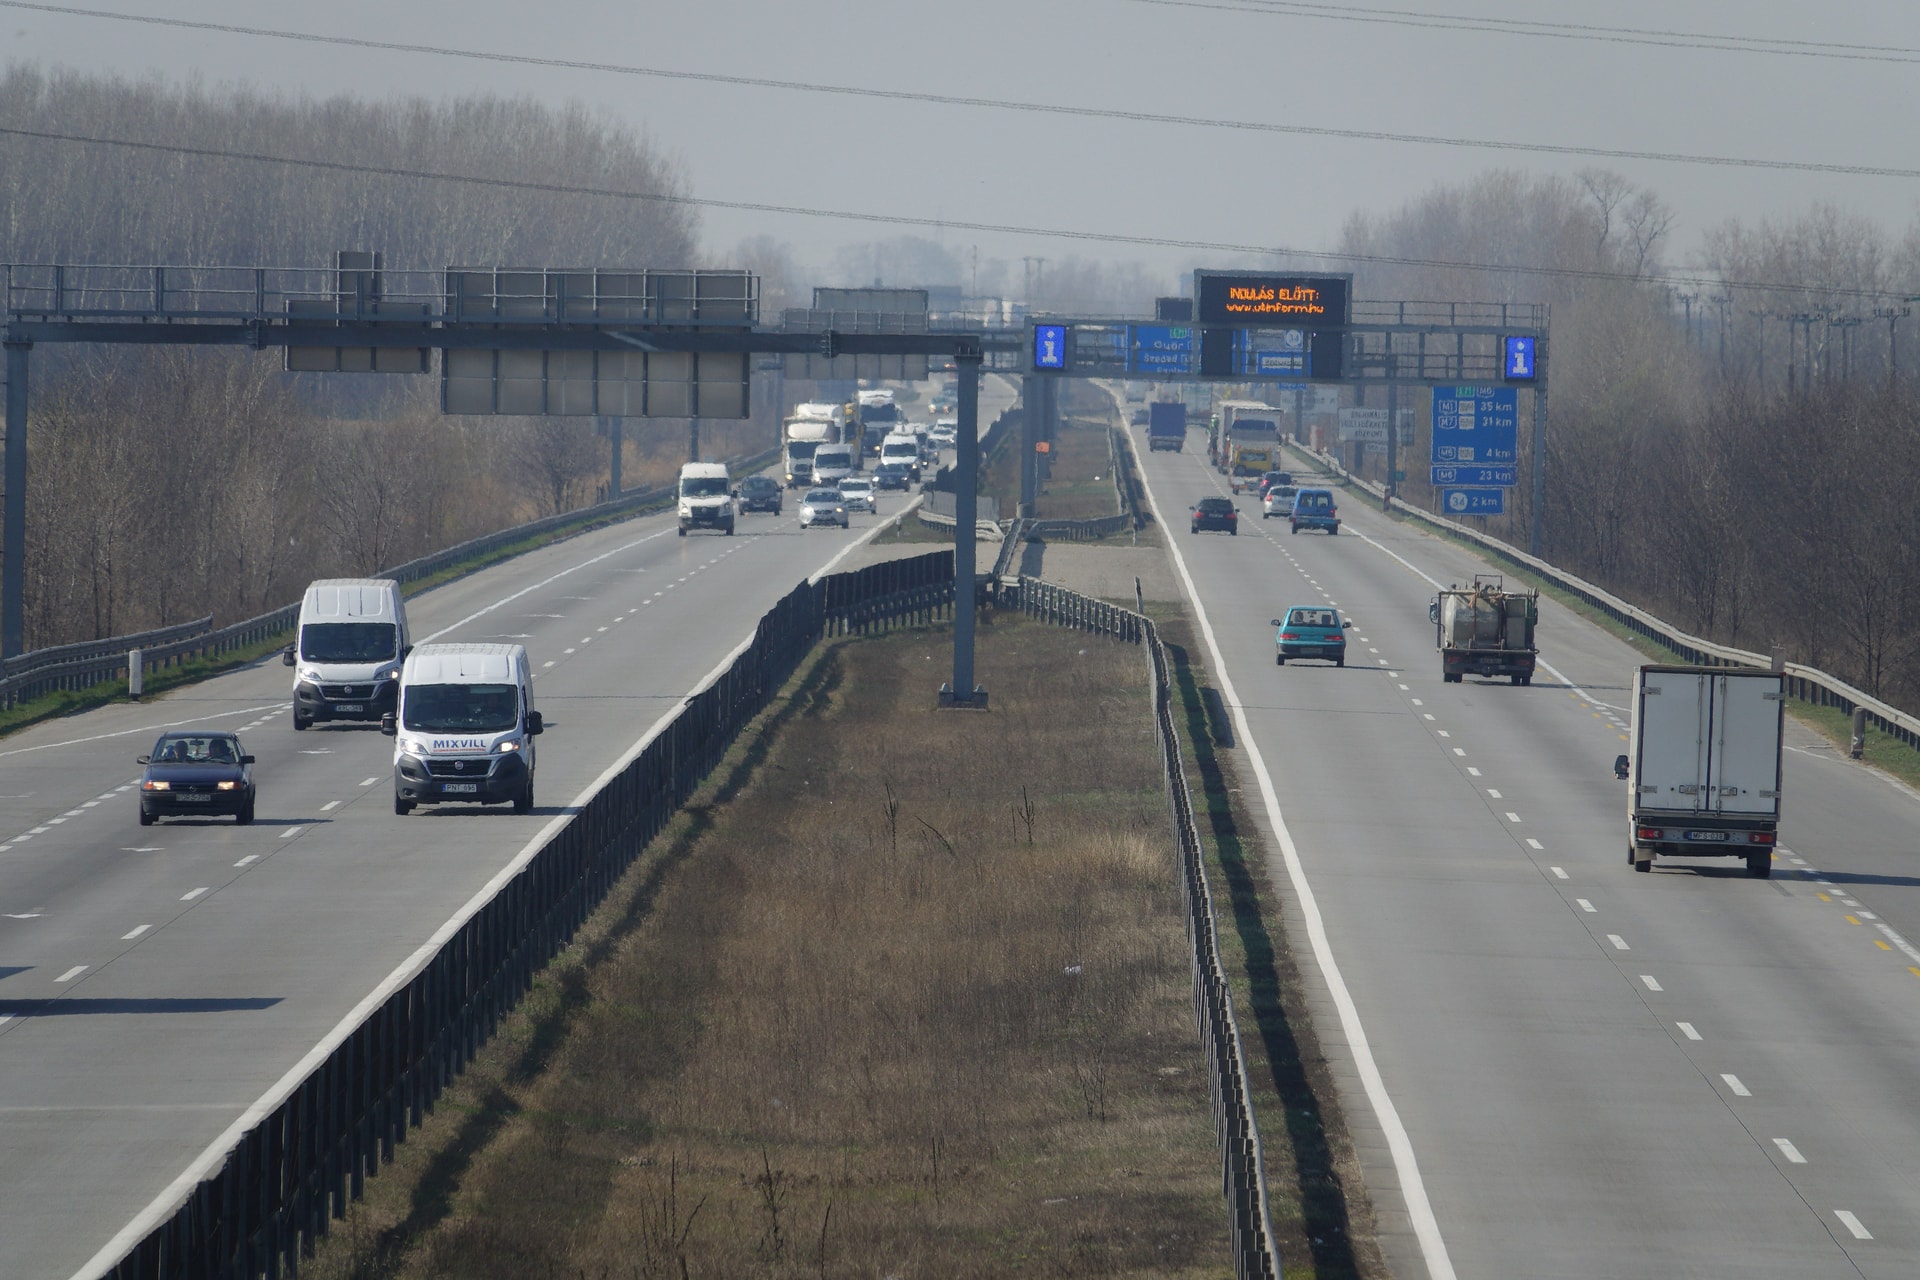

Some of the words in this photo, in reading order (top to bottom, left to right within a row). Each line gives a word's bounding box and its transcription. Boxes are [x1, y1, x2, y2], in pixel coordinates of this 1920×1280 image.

[1229, 285, 1275, 301] INDULÁS
[1480, 401, 1493, 411] 35
[1495, 401, 1512, 411] km
[1495, 416, 1512, 427] km
[1486, 448, 1492, 457] 4
[1495, 448, 1511, 458] km
[1479, 470, 1492, 480] 23
[1495, 471, 1511, 481] km
[1452, 496, 1465, 506] 34
[1472, 497, 1479, 507] 2
[1481, 496, 1497, 506] km
[433, 739, 487, 748] MIXVILL
